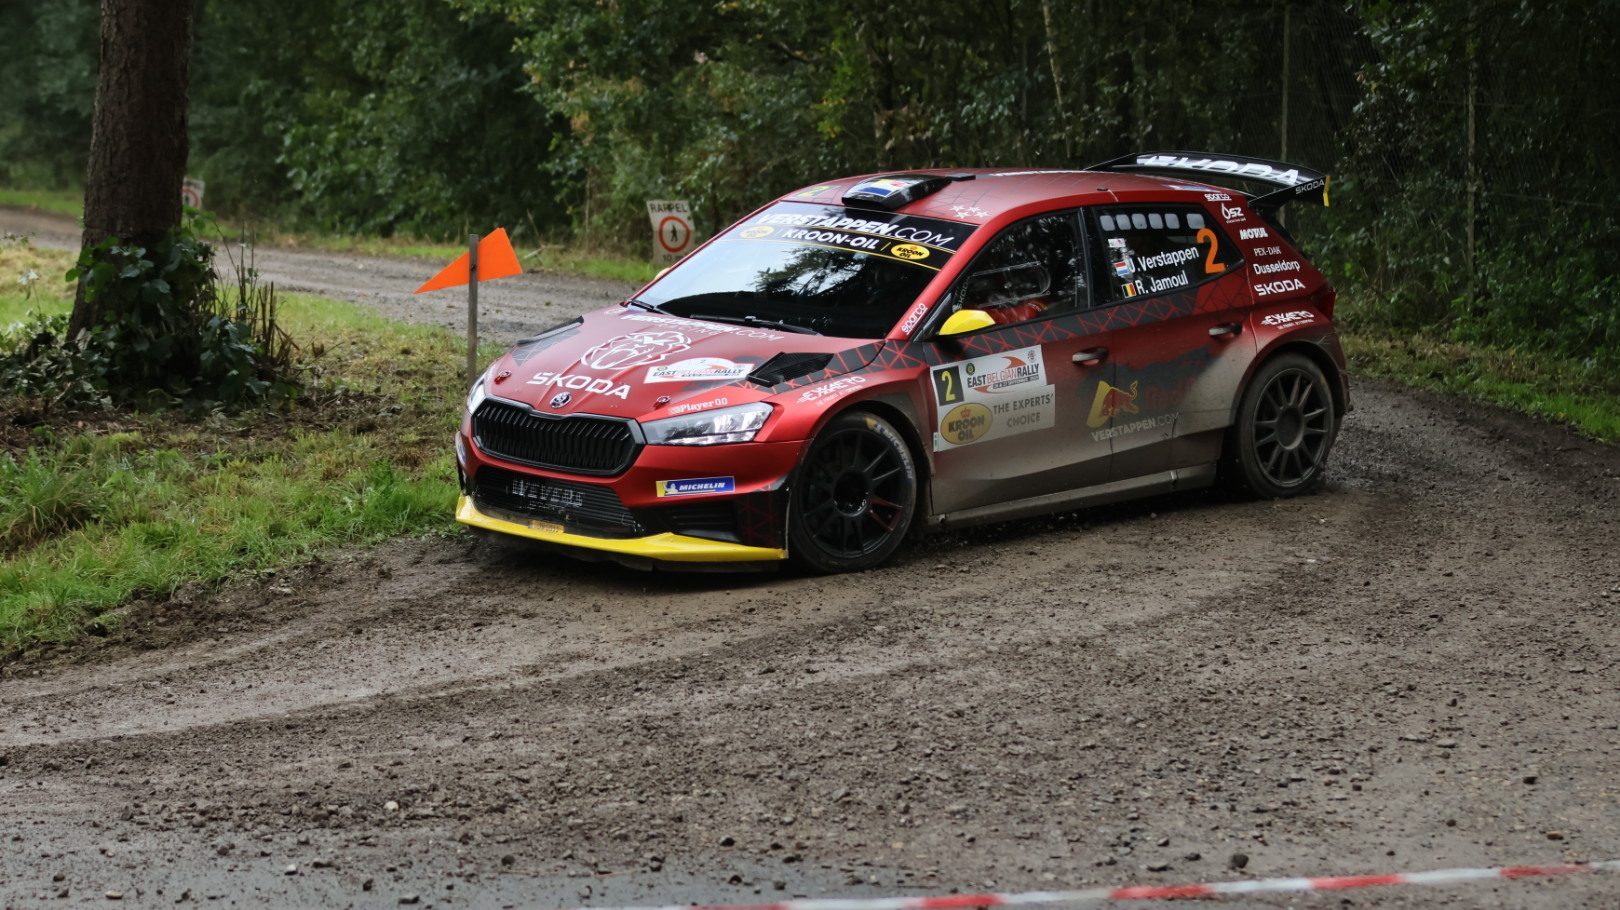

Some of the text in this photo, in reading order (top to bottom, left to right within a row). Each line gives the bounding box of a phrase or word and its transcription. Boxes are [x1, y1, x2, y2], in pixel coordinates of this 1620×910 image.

[756, 213, 955, 247] VERSTAPPEN.COM
[781, 228, 879, 250] KROON-OIL
[1240, 227, 1268, 240] MOTUL
[897, 247, 924, 257] KROON
[1197, 228, 1225, 274] 2
[1253, 246, 1282, 257] PEX-DAK
[1253, 260, 1300, 276] Dusseldorp
[1135, 270, 1189, 295] R. Jamoul
[1254, 278, 1306, 296] SKODA
[901, 303, 928, 335] sparco
[967, 374, 986, 388] EAST
[1017, 363, 1040, 377] RALLY
[526, 372, 631, 400] SKODA
[941, 370, 956, 402] 2
[681, 401, 715, 413] Player
[993, 402, 1010, 415] THE
[948, 415, 985, 433] KROON
[1007, 412, 1041, 428] CHOICE
[957, 429, 974, 441] OIL
[679, 482, 726, 491] MICHELIN
